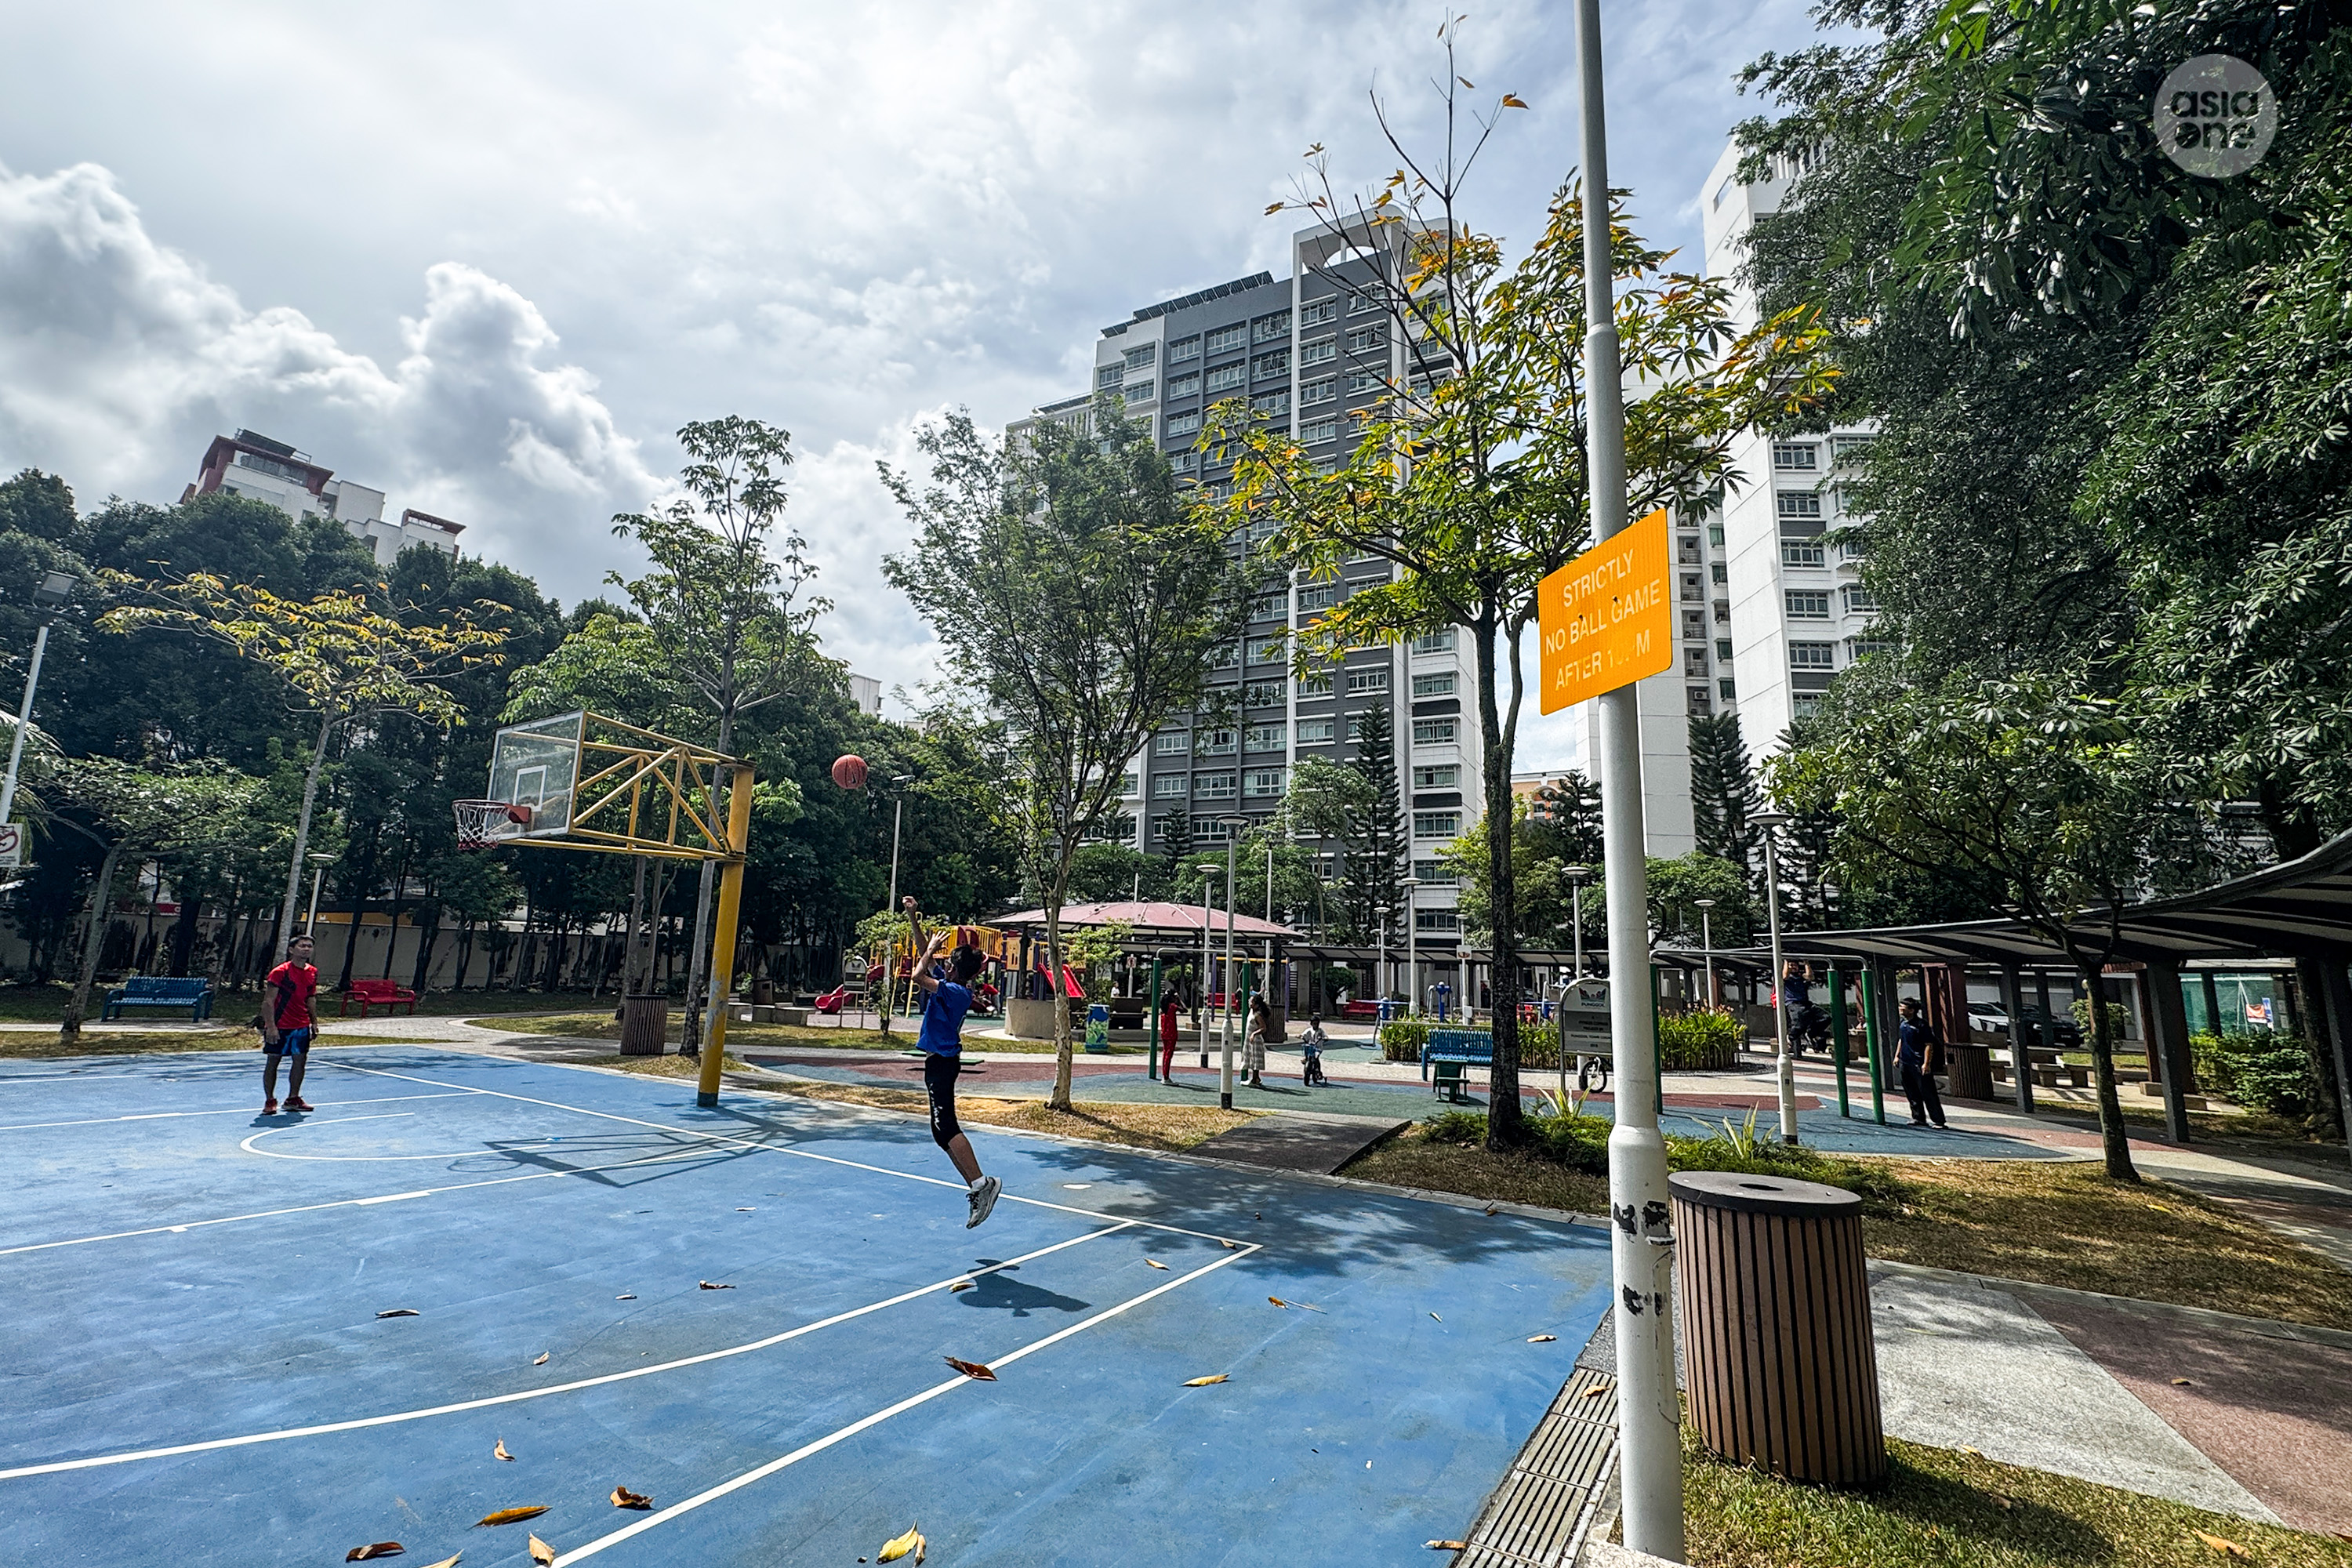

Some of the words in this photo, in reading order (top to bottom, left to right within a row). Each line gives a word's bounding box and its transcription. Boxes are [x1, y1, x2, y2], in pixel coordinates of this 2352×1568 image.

[1563, 548, 1634, 608] STRICTLY
[1545, 627, 1566, 657] NO
[1570, 608, 1607, 645] BALL
[1610, 579, 1661, 624] GAME
[1555, 650, 1602, 691] AFTER
